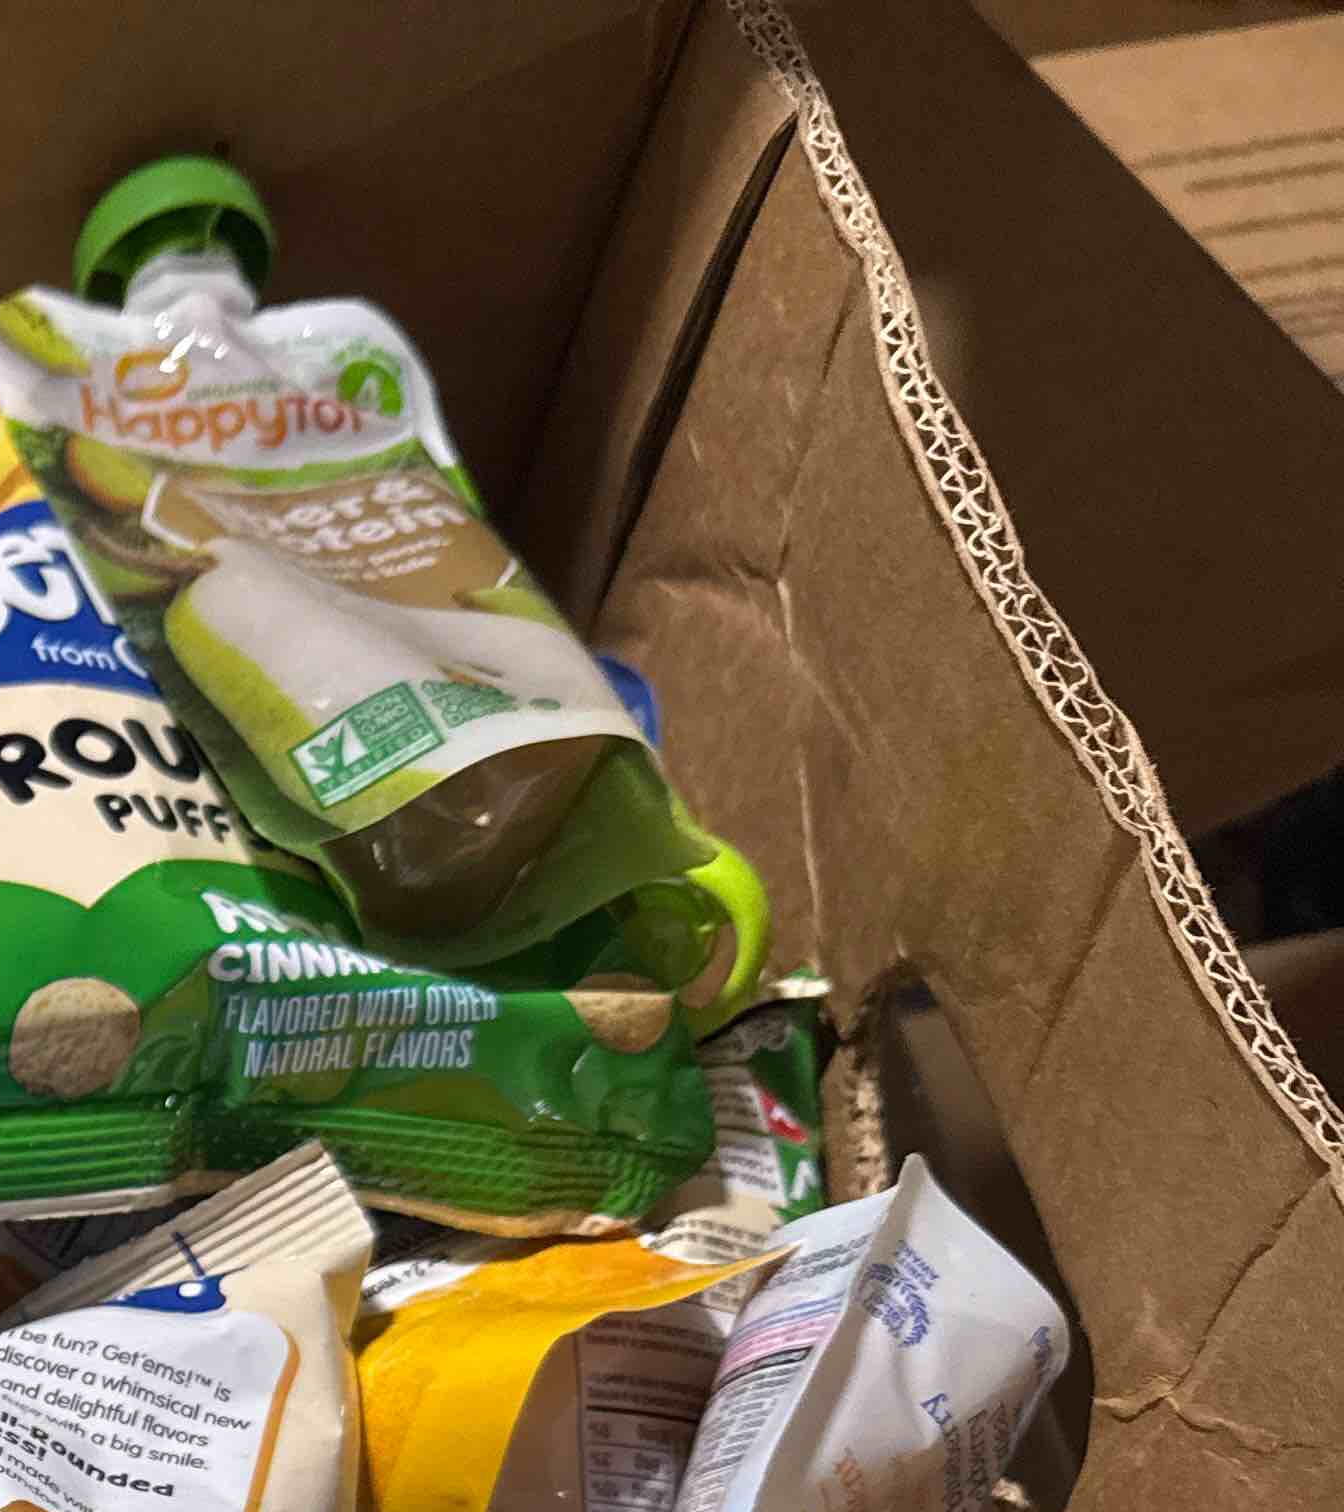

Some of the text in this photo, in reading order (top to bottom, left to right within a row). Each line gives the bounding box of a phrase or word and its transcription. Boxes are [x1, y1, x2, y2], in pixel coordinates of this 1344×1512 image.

[30, 634, 116, 672] from
[95, 792, 237, 850] PUFF
[224, 993, 351, 1035] FLAVORED
[355, 987, 418, 1027] WITH
[243, 1029, 476, 1078] NATURAL FLAVORS
[53, 1332, 98, 1355] fun?
[214, 1381, 232, 1402] is
[0, 1378, 209, 1447] and delightful flavors
[82, 1369, 97, 1386] a
[102, 1375, 201, 1420] whimsical
[203, 1411, 251, 1431] new
[90, 1430, 106, 1446] a
[110, 1433, 144, 1460] big
[147, 1448, 210, 1471] smile.
